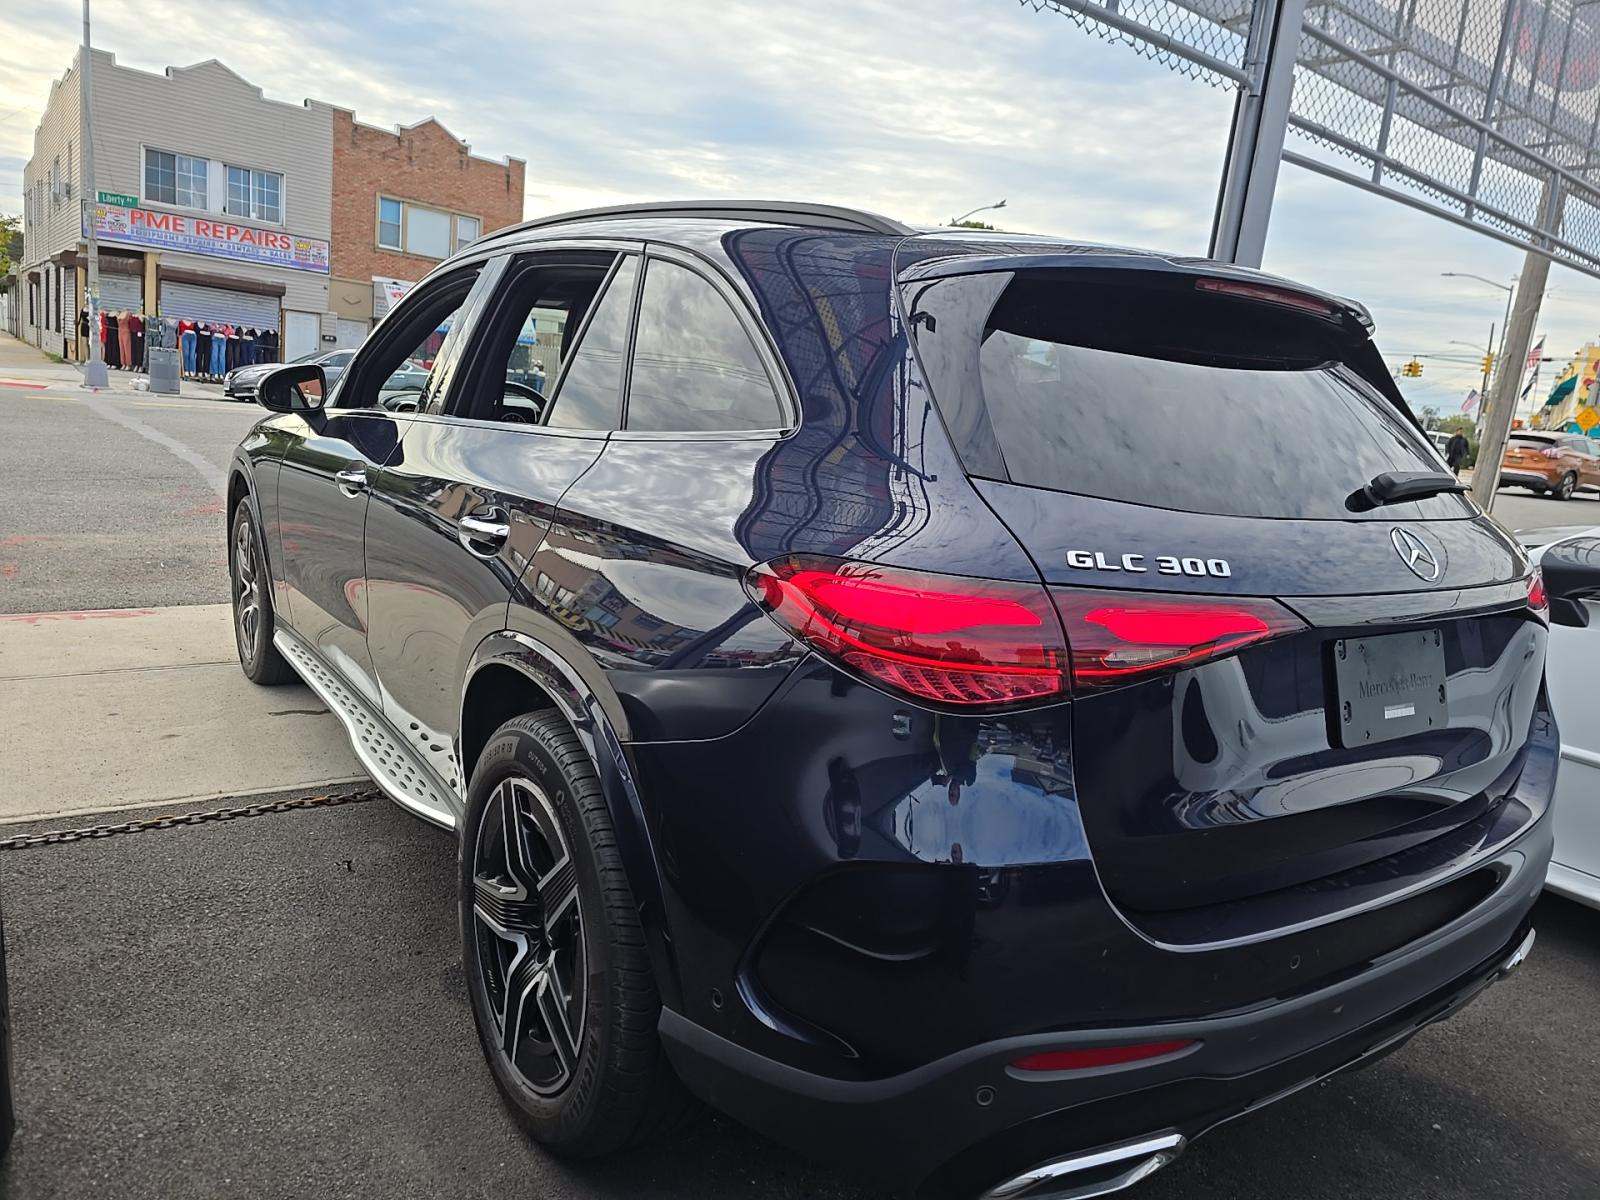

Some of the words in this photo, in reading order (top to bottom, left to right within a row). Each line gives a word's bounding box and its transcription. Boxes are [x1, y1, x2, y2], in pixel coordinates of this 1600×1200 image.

[102, 193, 125, 205] Liberty
[130, 209, 185, 233] PME
[195, 219, 291, 250] REPAIRS
[1066, 550, 1147, 572] GLC
[1155, 556, 1232, 577] 300
